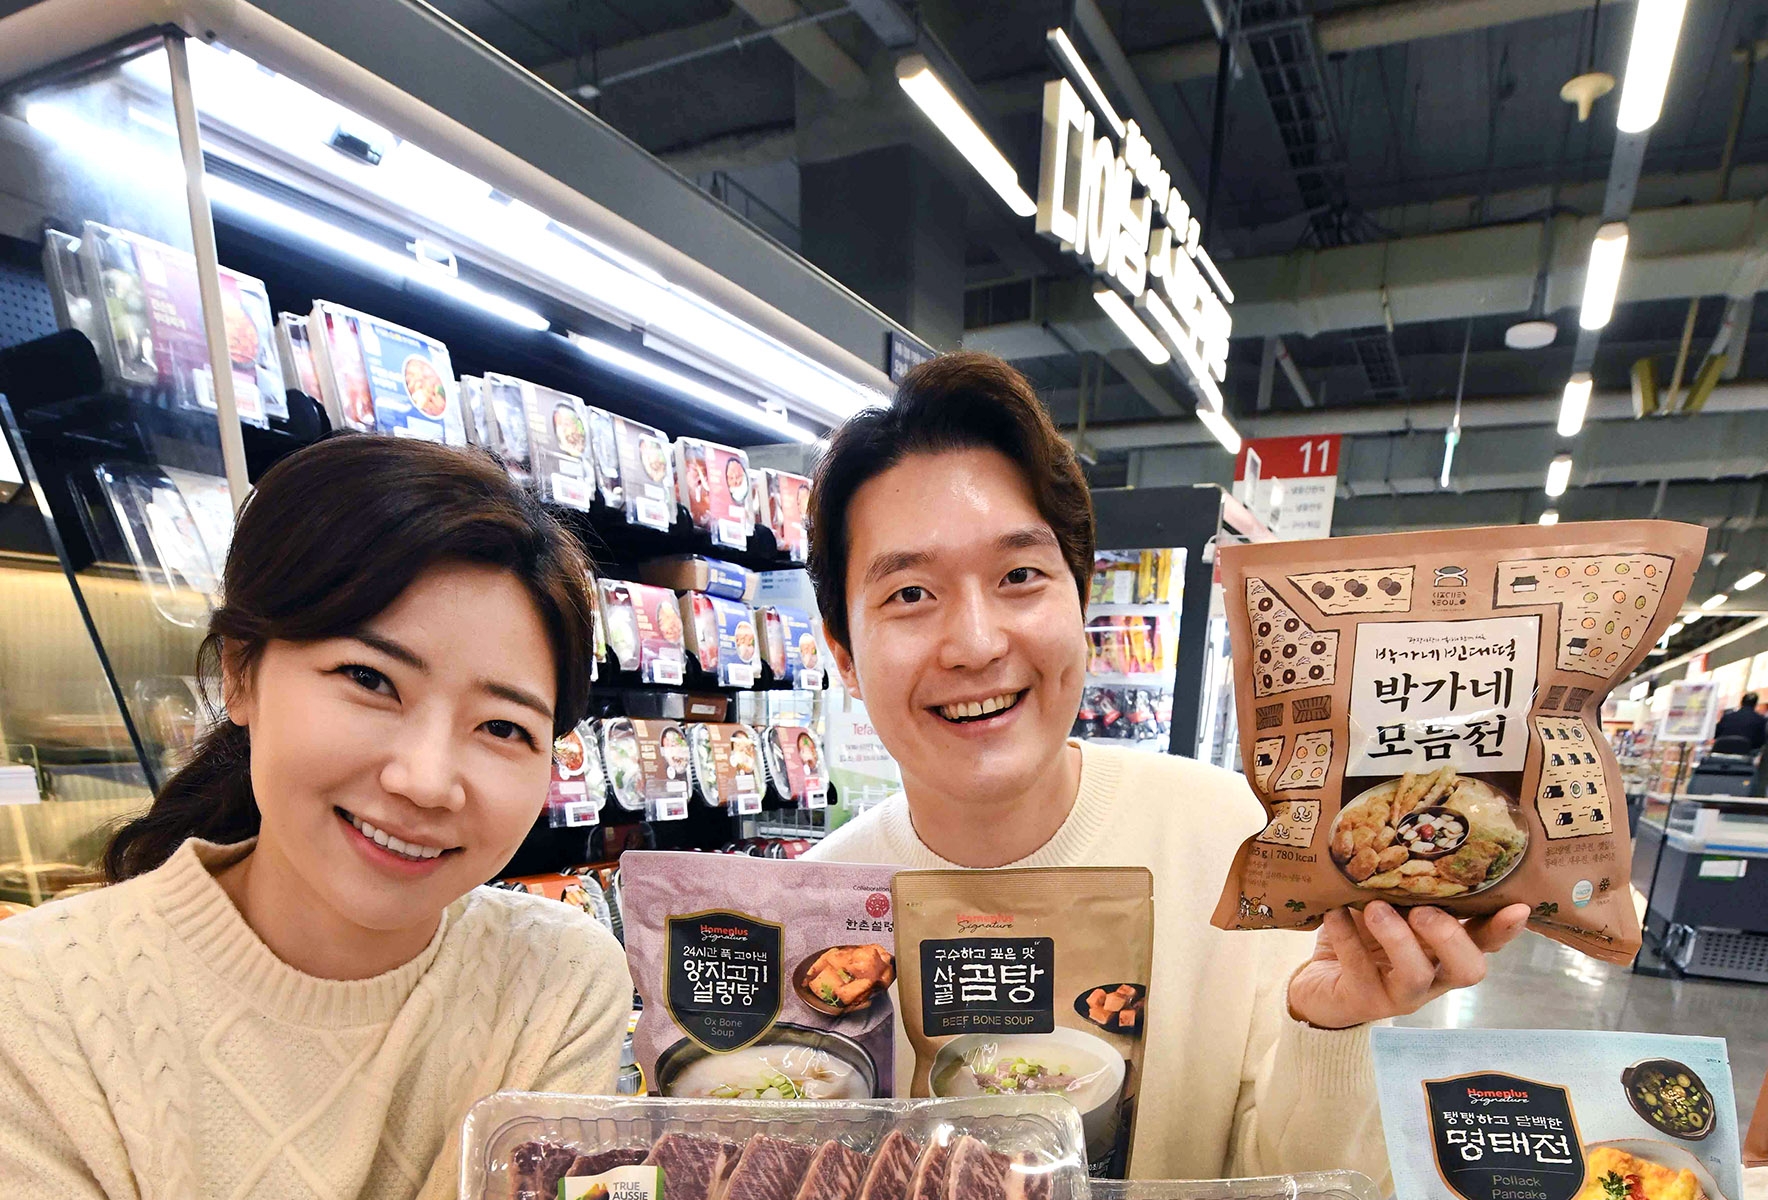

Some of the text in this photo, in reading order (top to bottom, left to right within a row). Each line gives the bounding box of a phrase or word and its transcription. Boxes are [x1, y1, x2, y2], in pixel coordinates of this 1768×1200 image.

[1299, 440, 1330, 473] 11
[1375, 647, 1440, 664] 박가네
[1444, 638, 1516, 662] 빈대떡
[1373, 667, 1514, 713] 박가네
[852, 723, 878, 736] Tefa
[1276, 849, 1294, 860] 780
[1295, 852, 1317, 863] kcal
[700, 924, 749, 936] Homeplus
[846, 918, 894, 933] 한촌설렁
[957, 919, 1014, 933] Signature
[700, 929, 748, 942] Signature
[683, 945, 718, 958] 24시간
[734, 951, 767, 962] 고아낸
[934, 947, 986, 962] 구수하고
[1022, 946, 1035, 960] 맛
[683, 959, 768, 983] 양지고기
[959, 963, 1045, 1004] 곰탕
[693, 980, 759, 1006] 설렁탕
[704, 1017, 743, 1027] Ox Bone
[942, 1015, 1035, 1027] BEEF BONE SOUP
[711, 1027, 735, 1038] Soup
[1466, 1087, 1529, 1098] Homeplus
[1468, 1093, 1530, 1106] Signature
[1443, 1111, 1564, 1131] 탱탱하고 담백한
[1446, 1128, 1573, 1164] 명태전
[613, 1182, 640, 1191] TRUE
[1492, 1174, 1542, 1187] Pollack
[612, 1191, 649, 1200] AUSSIE
[1492, 1188, 1547, 1200] Pancake
